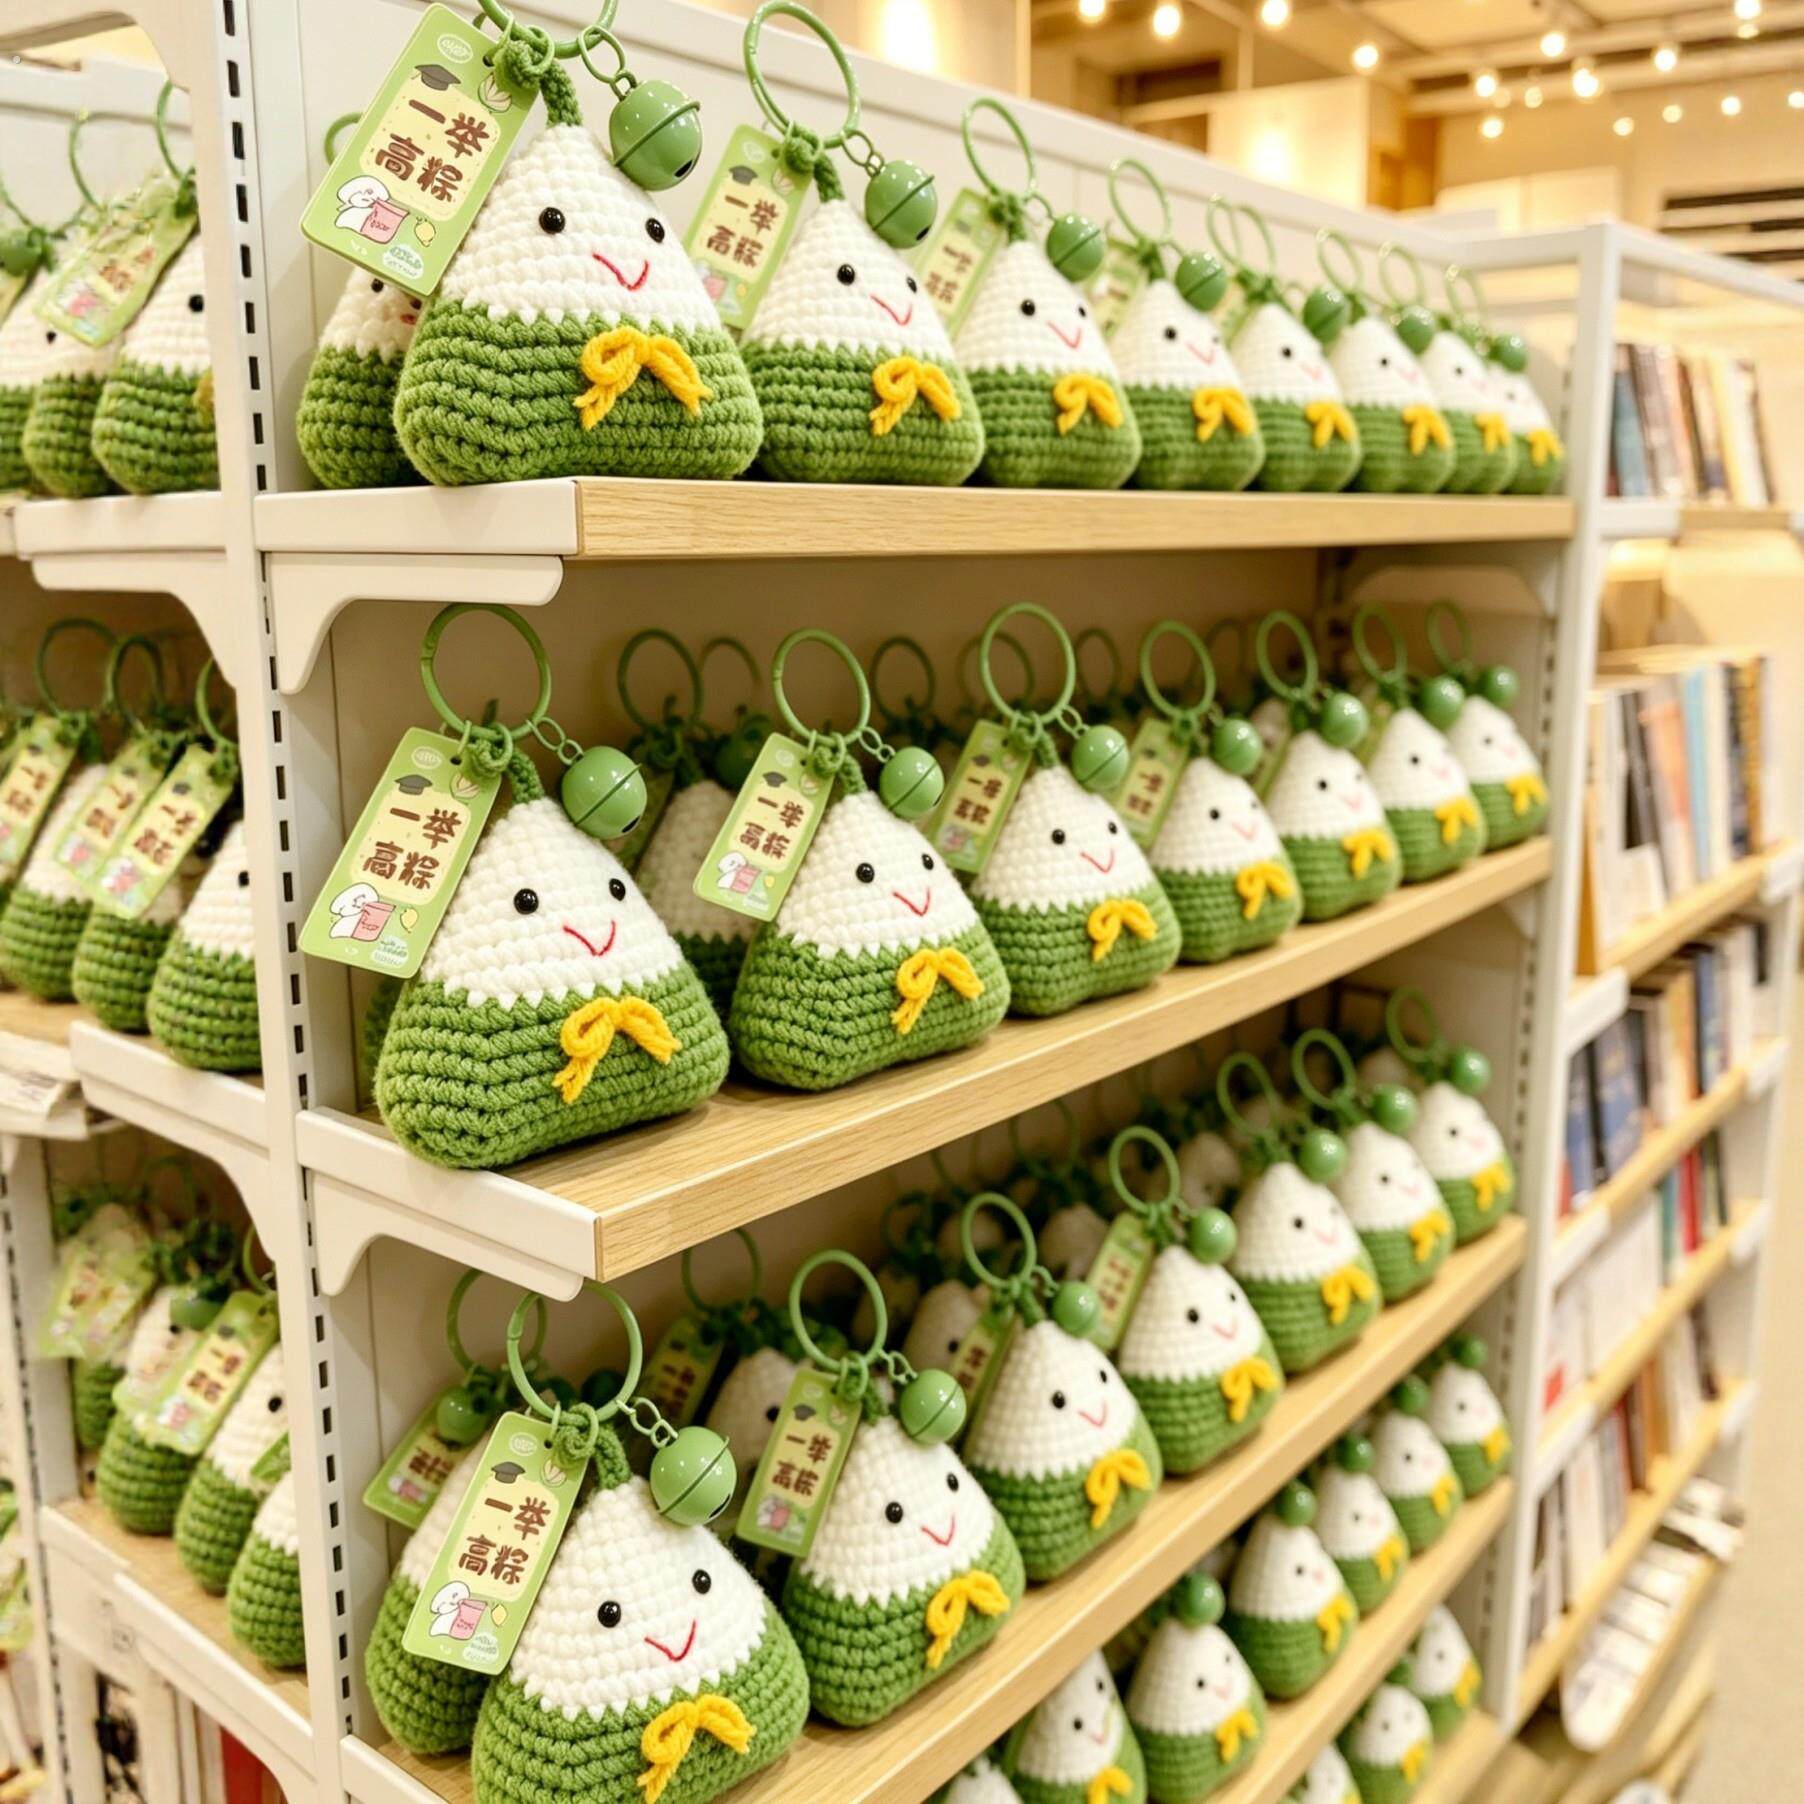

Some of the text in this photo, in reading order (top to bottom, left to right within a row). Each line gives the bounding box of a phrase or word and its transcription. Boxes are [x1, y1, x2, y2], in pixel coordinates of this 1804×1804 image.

[408, 99, 490, 158] 一举
[375, 133, 463, 202] 高粽
[390, 808, 462, 849] 一举
[362, 840, 440, 889] 高粽
[484, 1496, 551, 1541] 一举
[458, 1534, 529, 1585] 高粽
